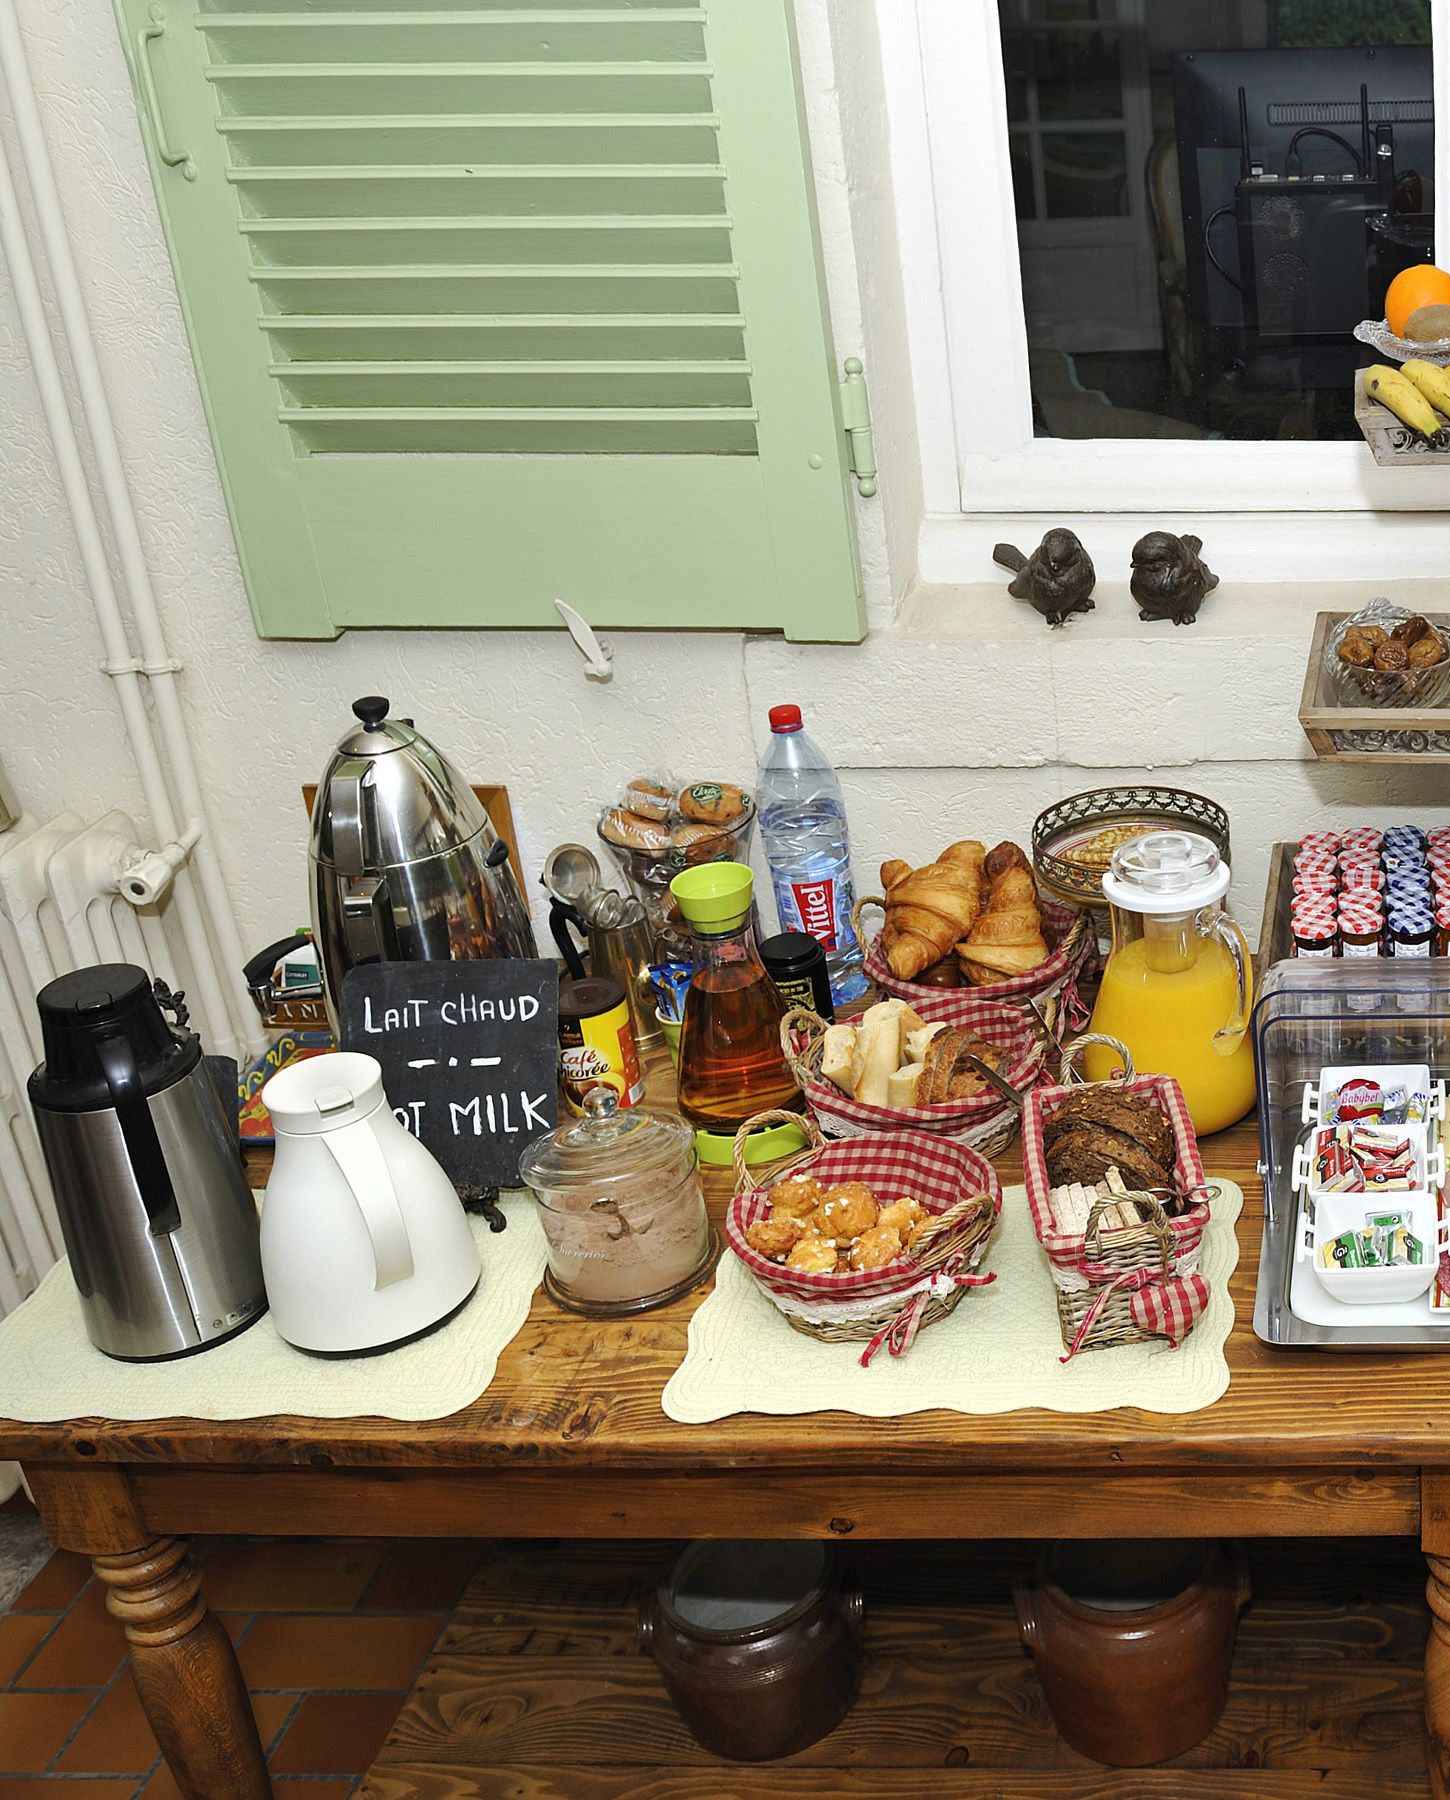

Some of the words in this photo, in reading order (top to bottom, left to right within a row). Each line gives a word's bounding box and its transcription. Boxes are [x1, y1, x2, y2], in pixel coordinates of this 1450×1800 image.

[800, 883, 832, 941] Vittel
[364, 996, 429, 1033] LAIT
[559, 1061, 611, 1078] hicorée
[560, 1049, 598, 1070] Café
[1341, 1092, 1379, 1106] Babybel
[393, 1101, 426, 1138] OT
[449, 1090, 551, 1137] MILK
